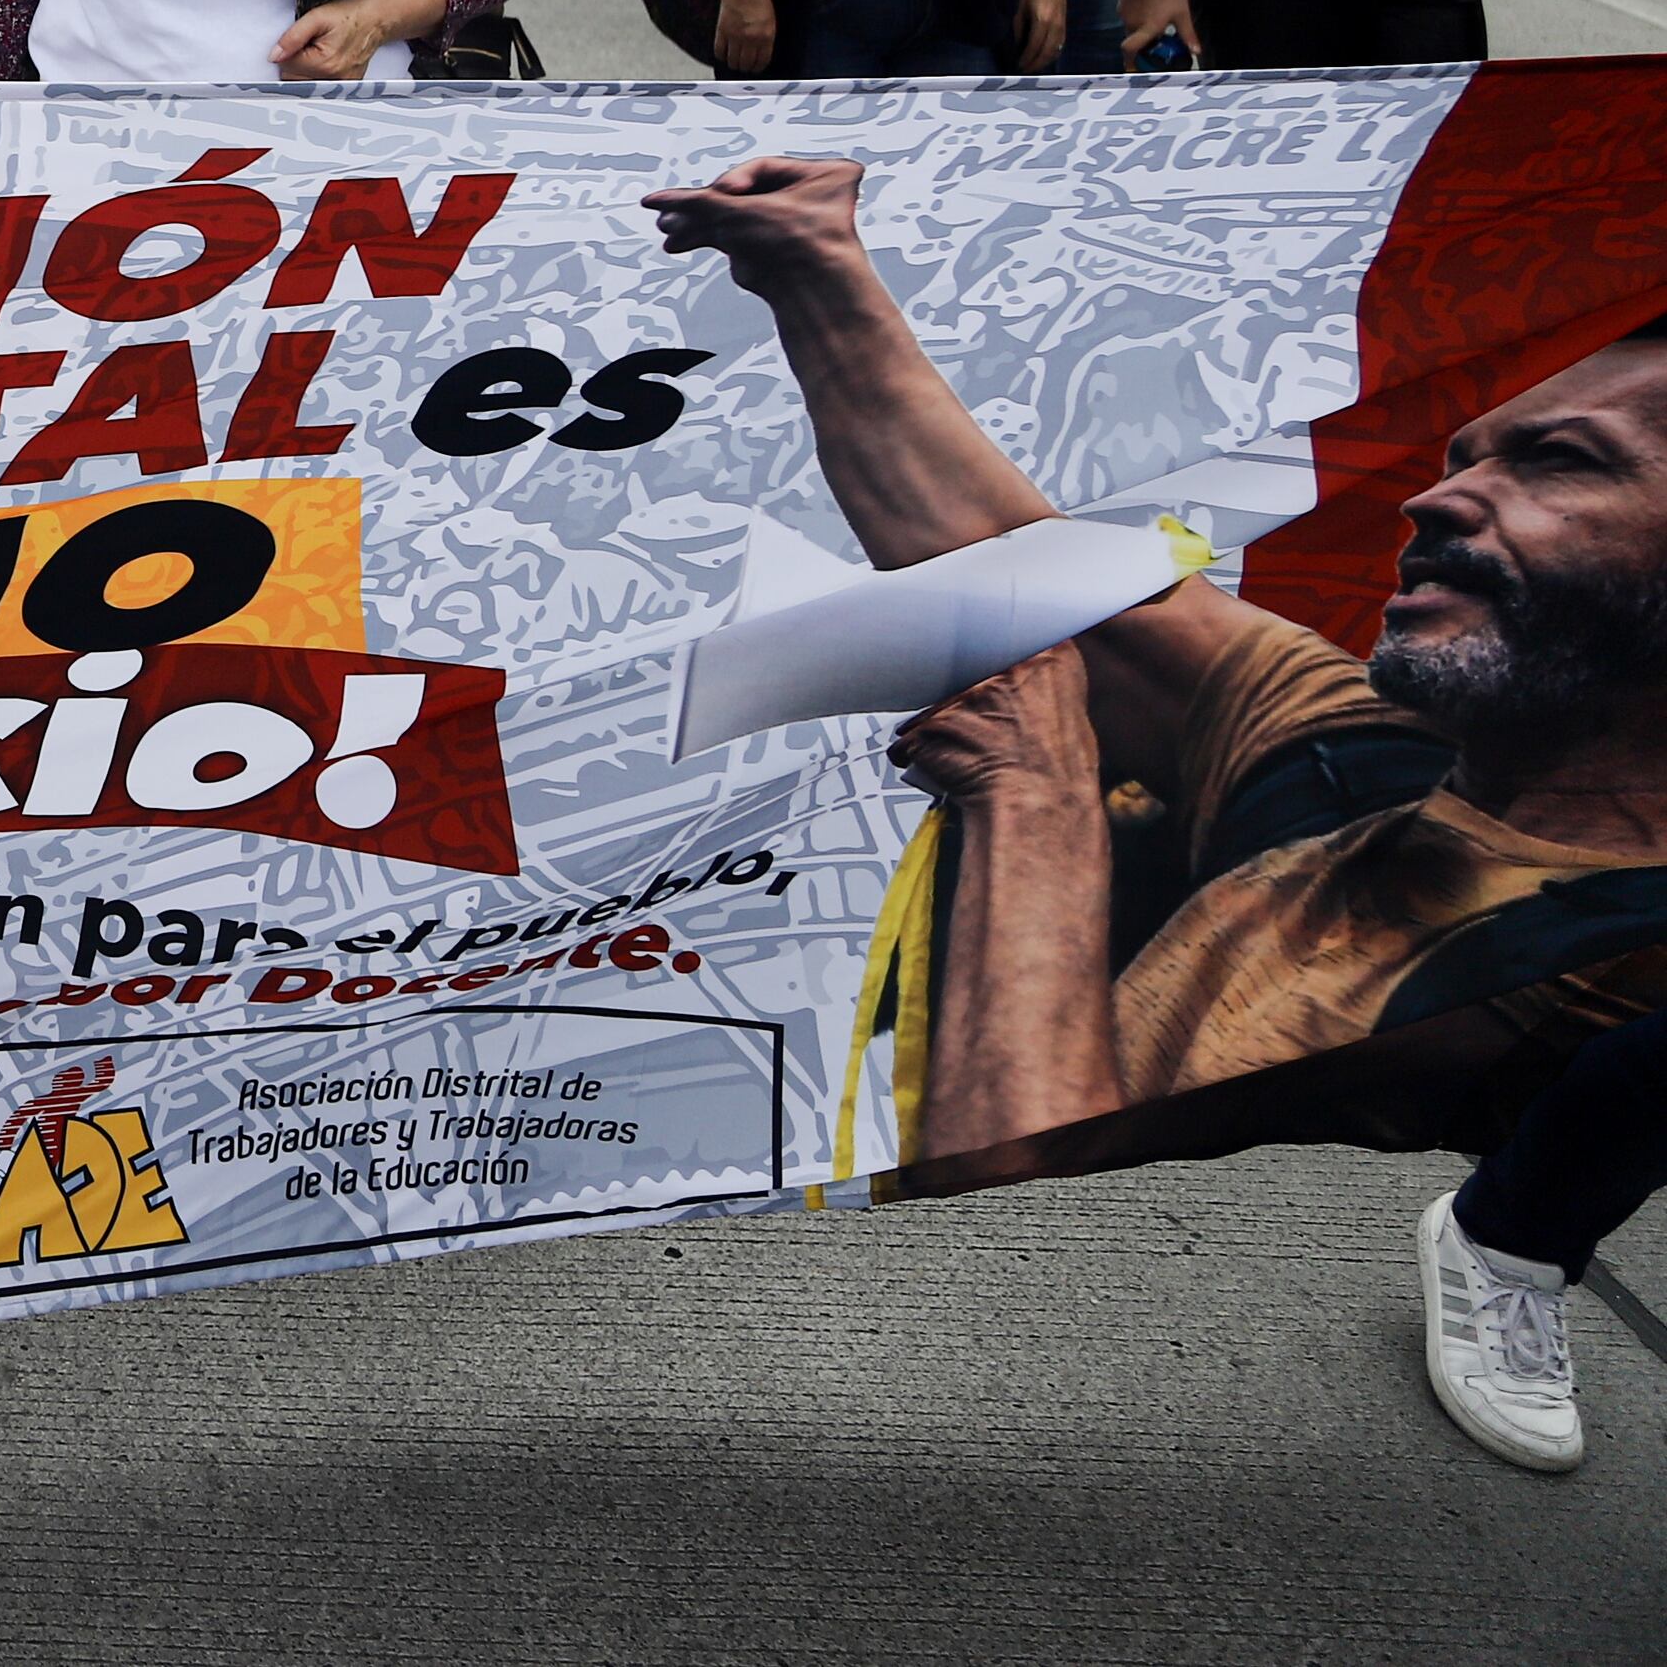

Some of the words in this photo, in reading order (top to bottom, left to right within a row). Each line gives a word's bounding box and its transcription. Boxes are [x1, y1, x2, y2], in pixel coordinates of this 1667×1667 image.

[410, 345, 717, 458] es
[238, 1068, 413, 1112] Asociación
[421, 1066, 553, 1101] Distrital
[560, 1069, 602, 1103] de
[187, 1115, 389, 1165] Trabajadores
[396, 1119, 415, 1152] y
[427, 1108, 640, 1151] Trabajadoras
[283, 1166, 323, 1202] de
[331, 1163, 359, 1198] la
[367, 1150, 529, 1192] Educación
